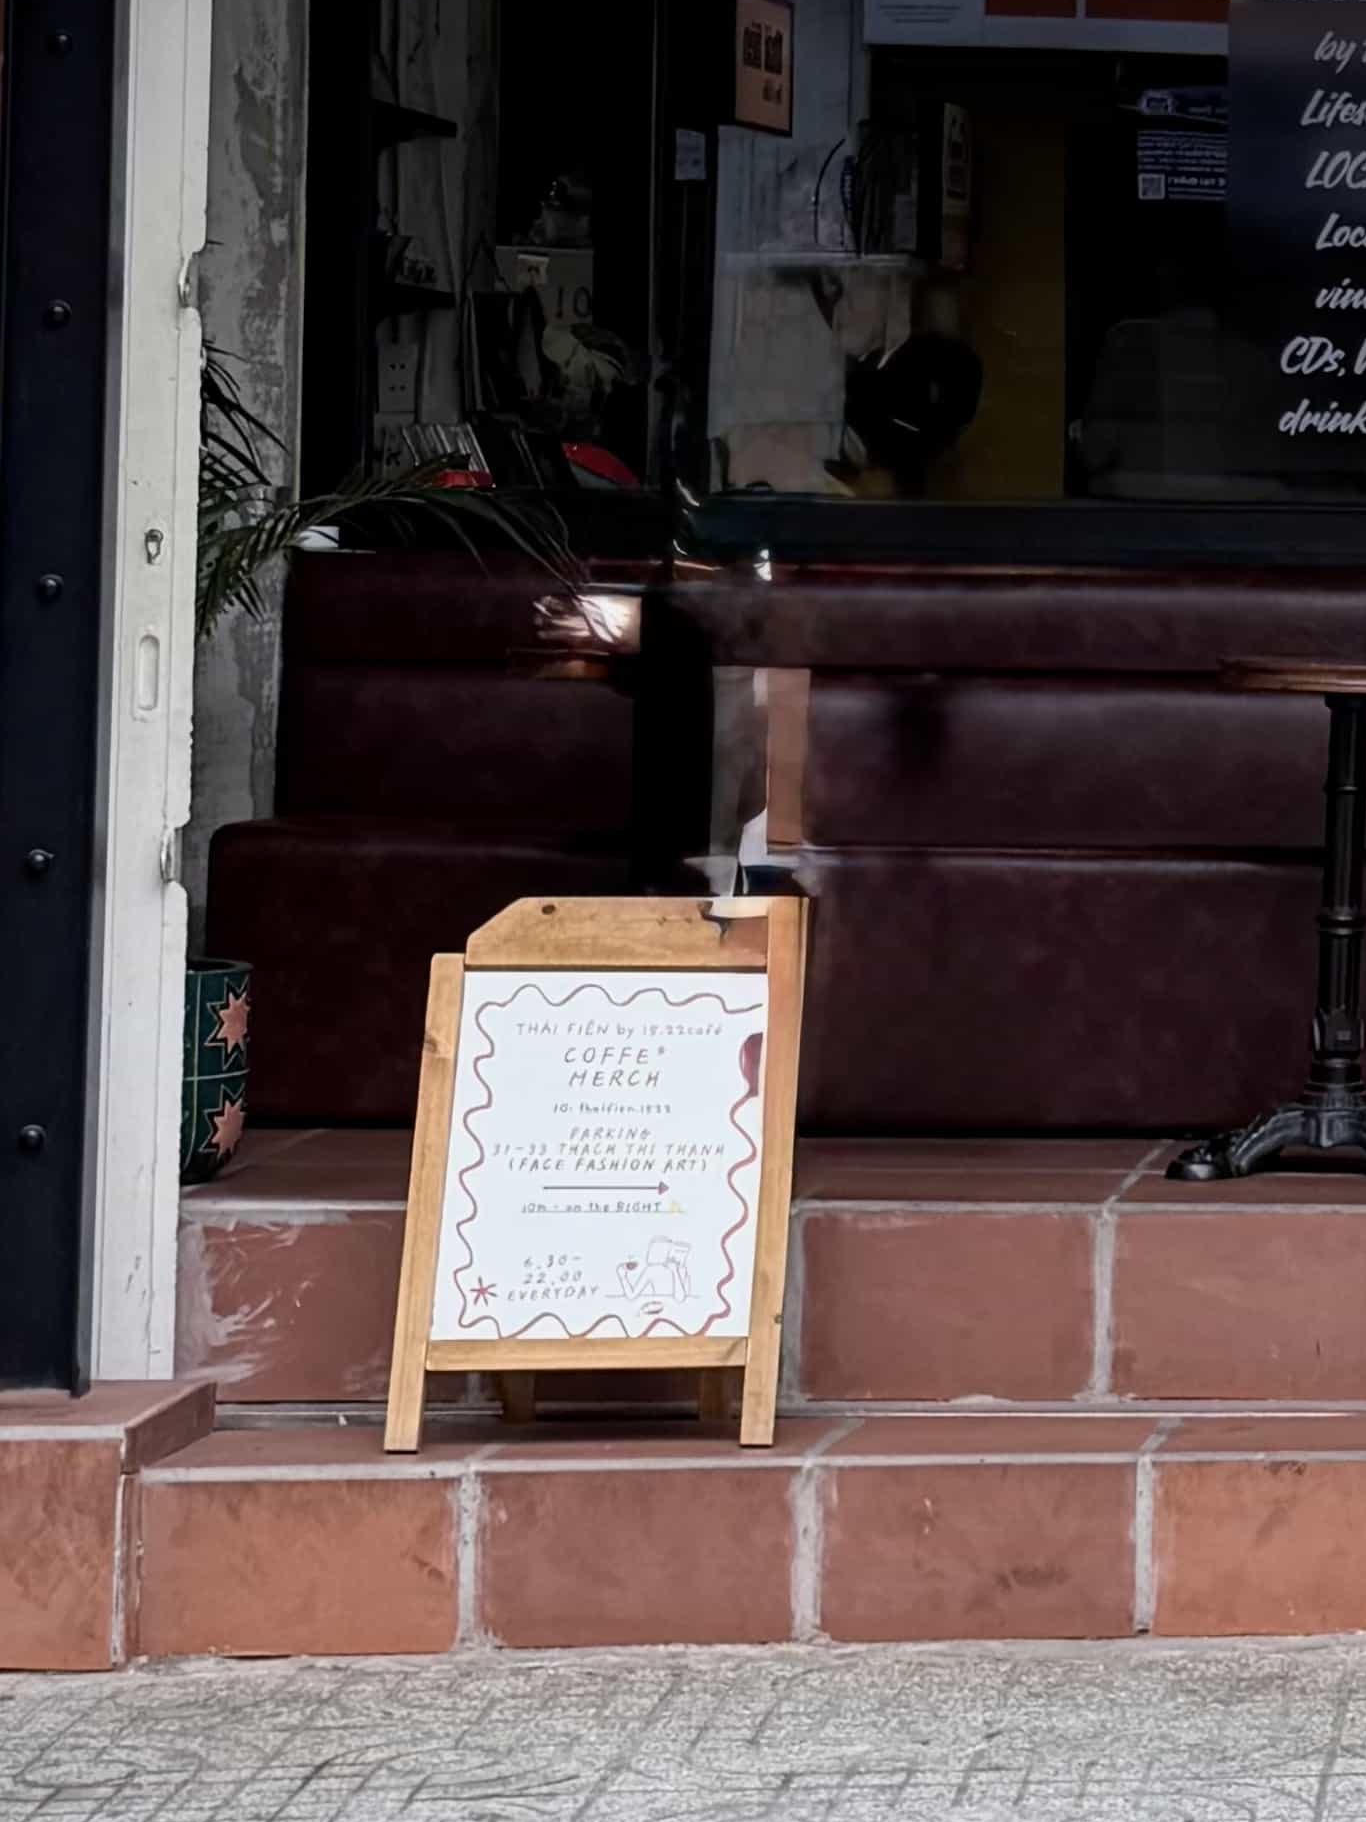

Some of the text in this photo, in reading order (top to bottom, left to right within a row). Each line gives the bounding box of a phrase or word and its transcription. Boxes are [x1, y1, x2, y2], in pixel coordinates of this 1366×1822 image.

[1313, 30, 1357, 74] by
[1279, 334, 1346, 378] CDs,
[616, 1021, 634, 1040] by
[568, 1068, 661, 1088] MERCH
[568, 1126, 651, 1141] PARKING
[665, 1143, 725, 1157] THANH
[508, 1157, 707, 1174] (FACE FASHION ART)
[588, 1200, 610, 1214] the
[507, 1284, 600, 1302] EVERYDAY
